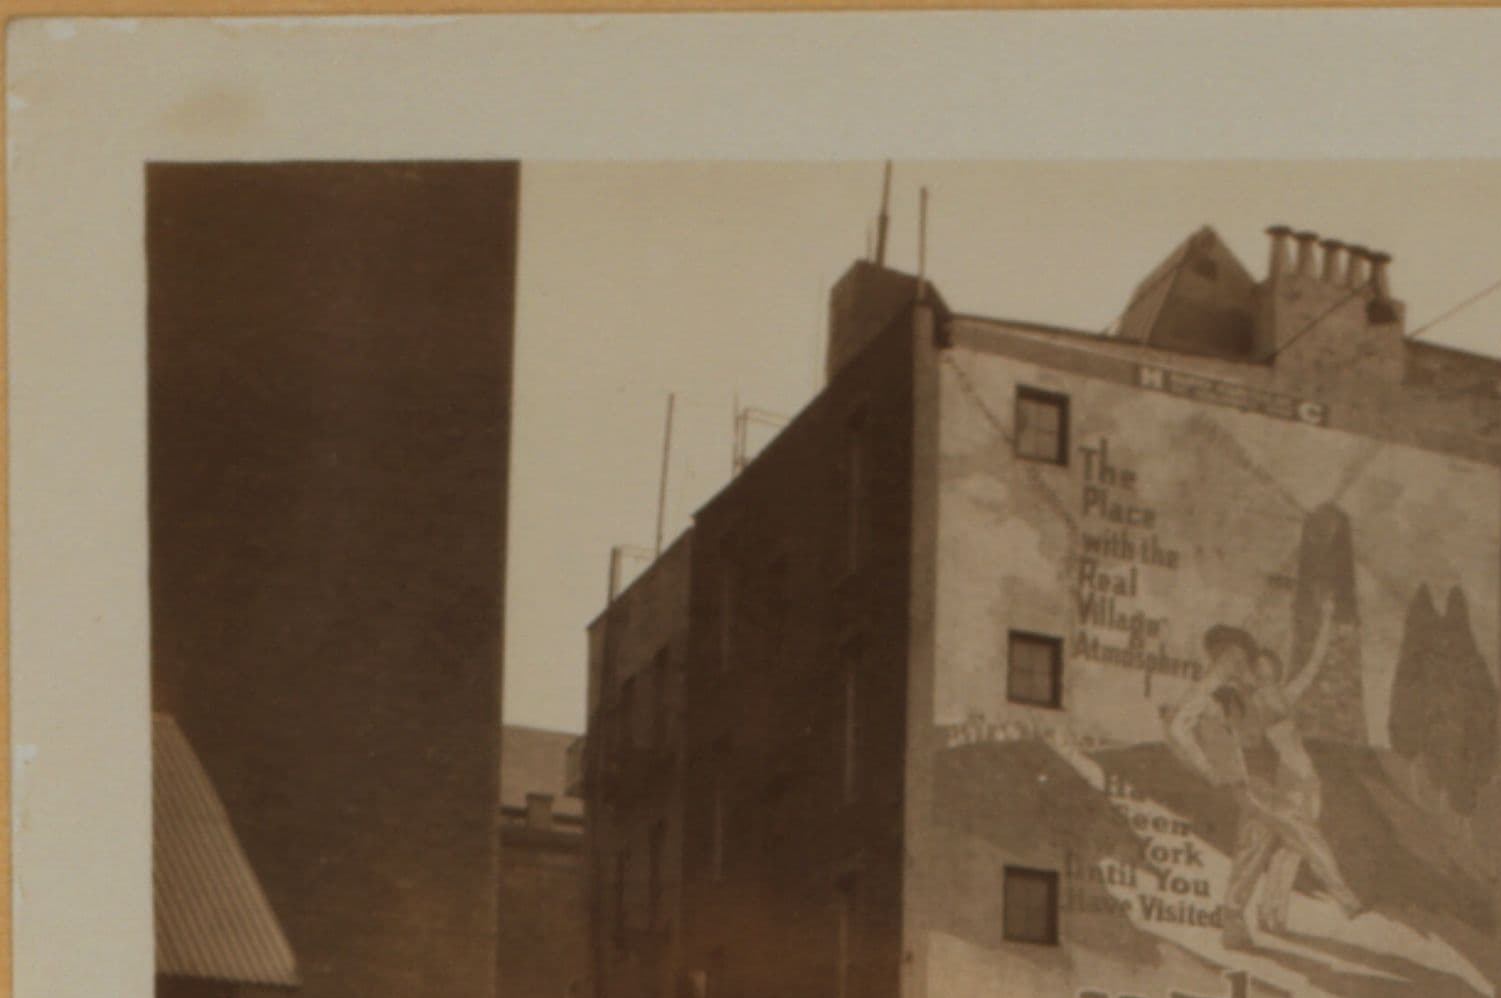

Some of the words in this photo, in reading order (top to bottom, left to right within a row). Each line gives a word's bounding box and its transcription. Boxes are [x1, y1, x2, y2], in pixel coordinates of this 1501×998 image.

[1078, 438, 1137, 490] The
[1083, 485, 1155, 530] Place
[1082, 527, 1135, 562] with
[1141, 533, 1179, 570] the
[1078, 556, 1138, 597] Real
[1152, 867, 1212, 898] You
[1138, 895, 1223, 929] Visited
